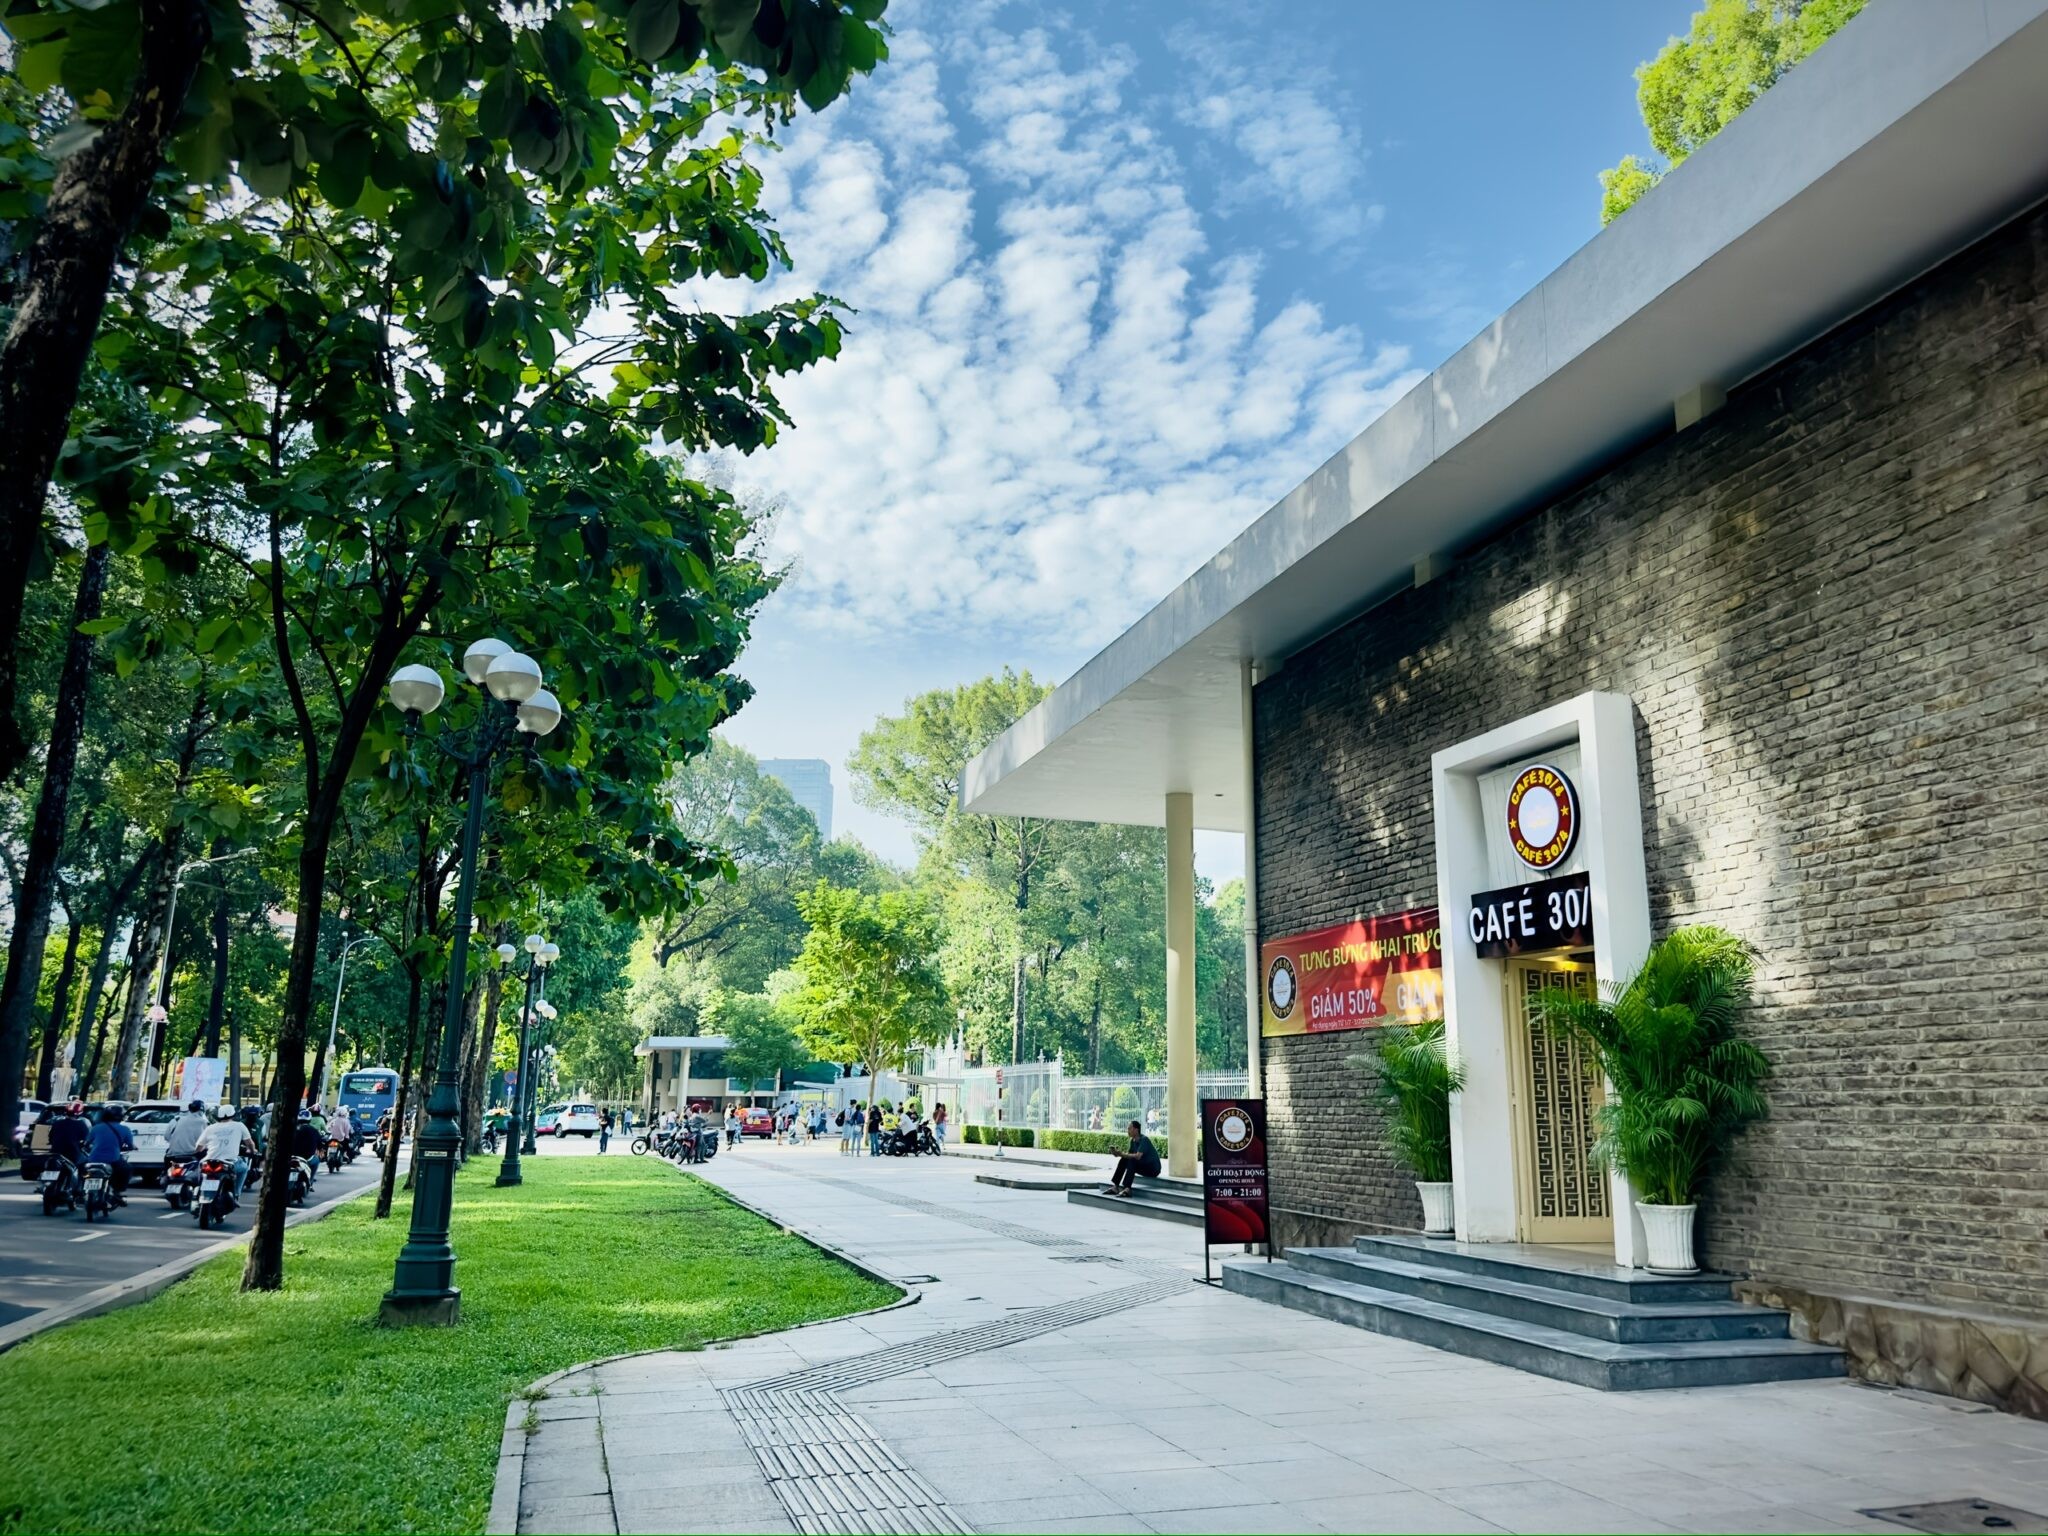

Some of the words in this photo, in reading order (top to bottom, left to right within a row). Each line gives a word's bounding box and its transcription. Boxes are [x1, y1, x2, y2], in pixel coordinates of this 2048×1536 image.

[1511, 770, 1537, 805] CAFÉ
[1538, 769, 1565, 797] 30/4
[1516, 840, 1543, 864] CAFÉ
[1543, 830, 1569, 862] 30/4
[1469, 887, 1536, 943] CAFÉ
[1332, 941, 1368, 967] BỪNG
[1370, 936, 1400, 961] KHAI
[1311, 987, 1344, 1019] GIẢM
[1348, 988, 1376, 1015] 50%
[1207, 1168, 1222, 1177] GIỜ
[1223, 1169, 1243, 1178] HOẠT
[1244, 1168, 1265, 1178] ĐỘNG
[1215, 1188, 1233, 1197] 7:00
[1240, 1188, 1262, 1197] 21:00
